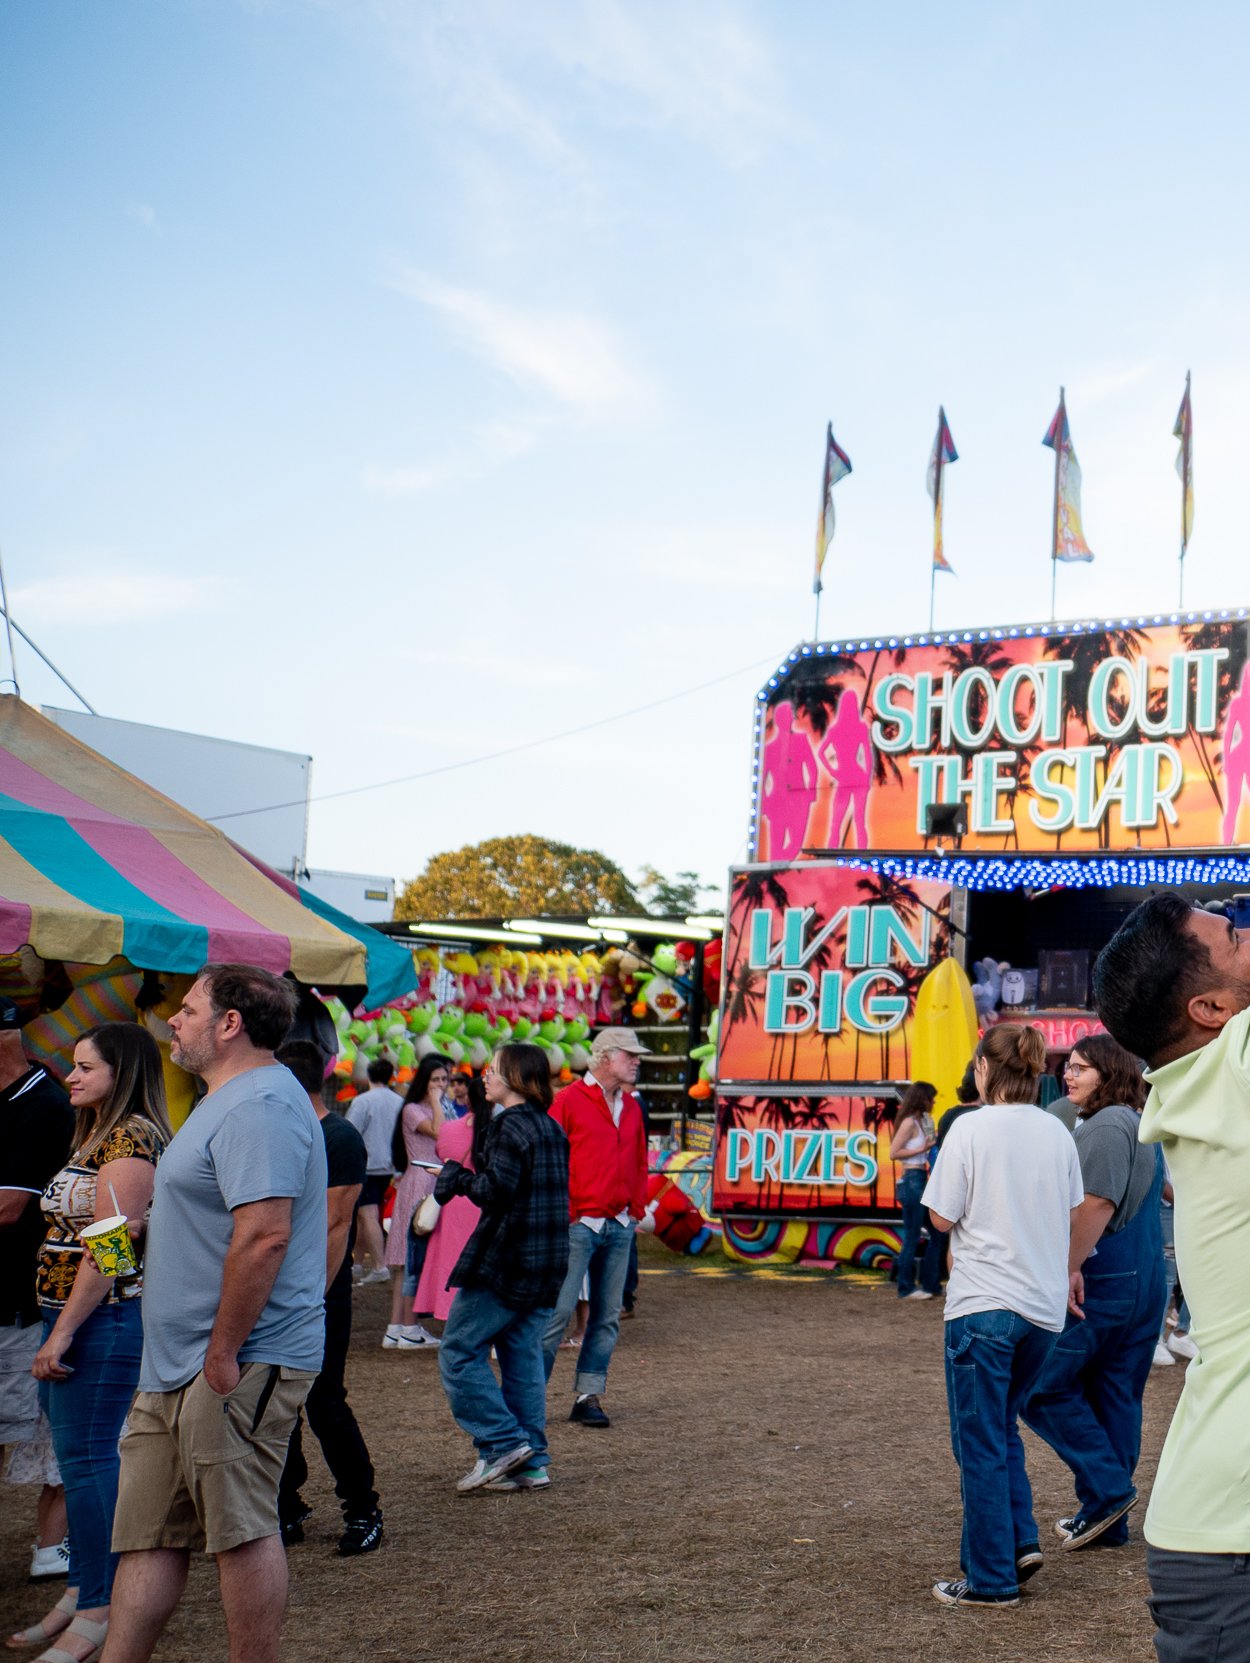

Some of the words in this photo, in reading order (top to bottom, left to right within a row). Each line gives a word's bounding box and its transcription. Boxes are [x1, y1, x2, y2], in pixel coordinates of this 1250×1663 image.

[872, 659, 1074, 751] SHOOT
[1090, 649, 1229, 737] OUT
[909, 750, 1017, 835] THE
[1029, 743, 1183, 833] STAR
[749, 905, 929, 969] WIN
[763, 969, 909, 1035] BIG
[725, 1128, 879, 1187] PRIZES
